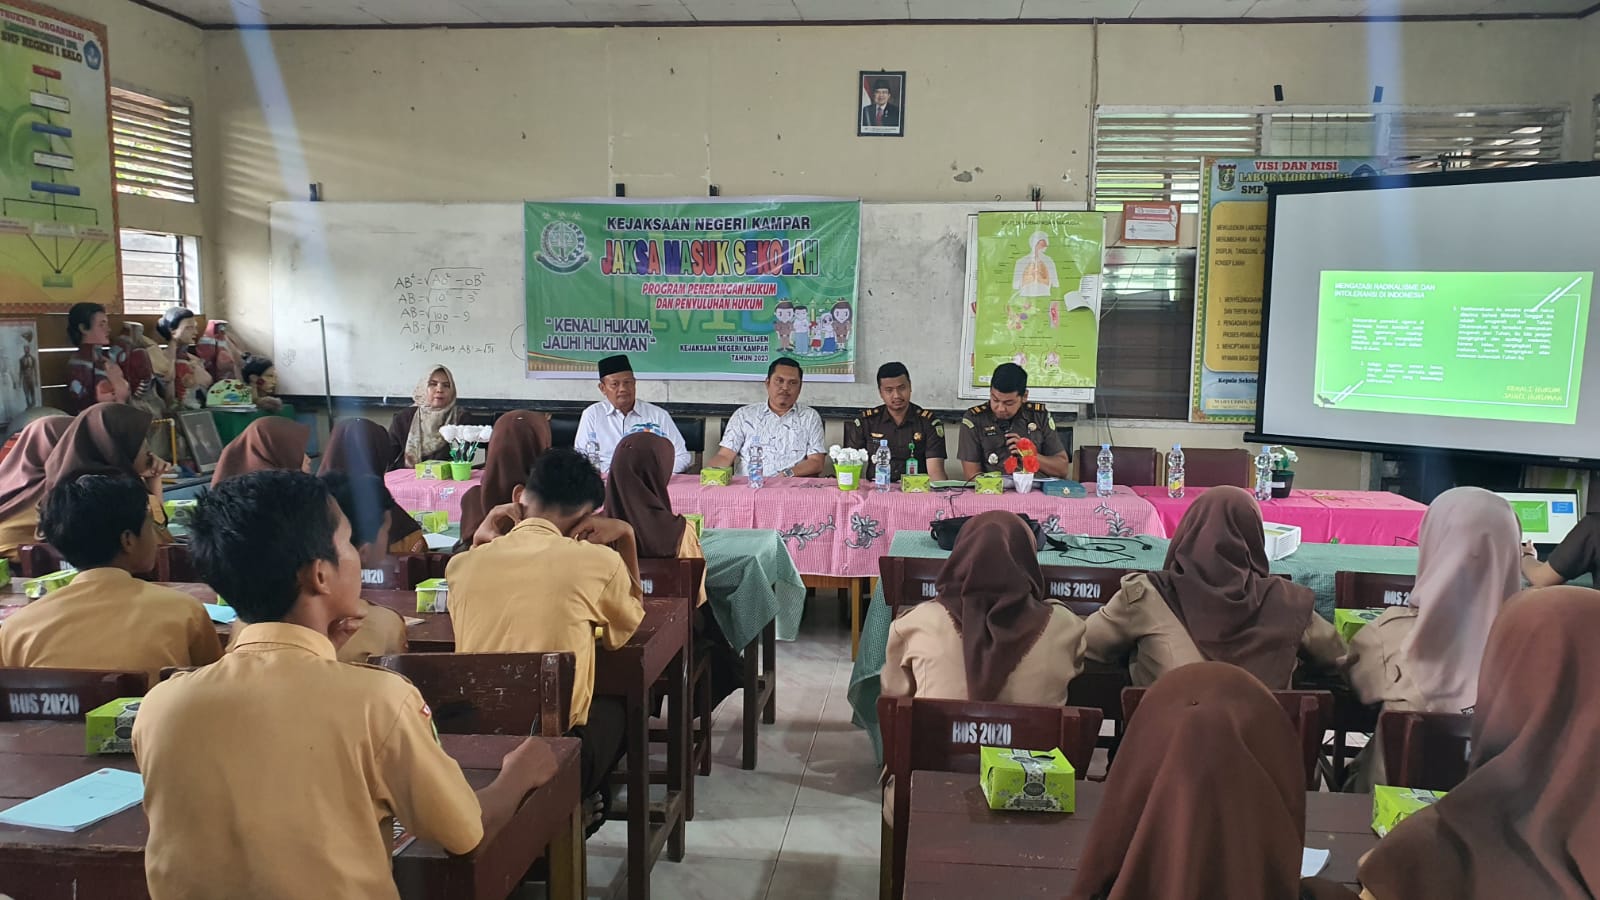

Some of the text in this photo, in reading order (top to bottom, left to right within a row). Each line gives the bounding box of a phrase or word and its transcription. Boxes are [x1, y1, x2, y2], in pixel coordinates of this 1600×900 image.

[1255, 161, 1338, 170] VISI DAN MISI
[1241, 185, 1264, 194] SMP
[607, 216, 811, 230] KEJAKSAAN NEGERI KAMPAR
[601, 239, 661, 275] JAKSA
[664, 239, 730, 275] MASUK
[733, 240, 819, 276] SEKOLAH
[642, 282, 777, 295] PROGRAM PENERANGAN HUKUM
[656, 298, 763, 310] DAN PENYULUHAN HUKUM
[554, 318, 600, 333] KENALI
[604, 319, 652, 335] HUKUM,
[542, 335, 581, 350] JAUHI
[584, 336, 648, 351] HUKUMAN
[736, 335, 769, 343] INTELIJEN
[922, 582, 938, 597] BO
[1073, 582, 1100, 599] 2020
[40, 692, 80, 715] 2020
[980, 722, 1012, 745] 2020
